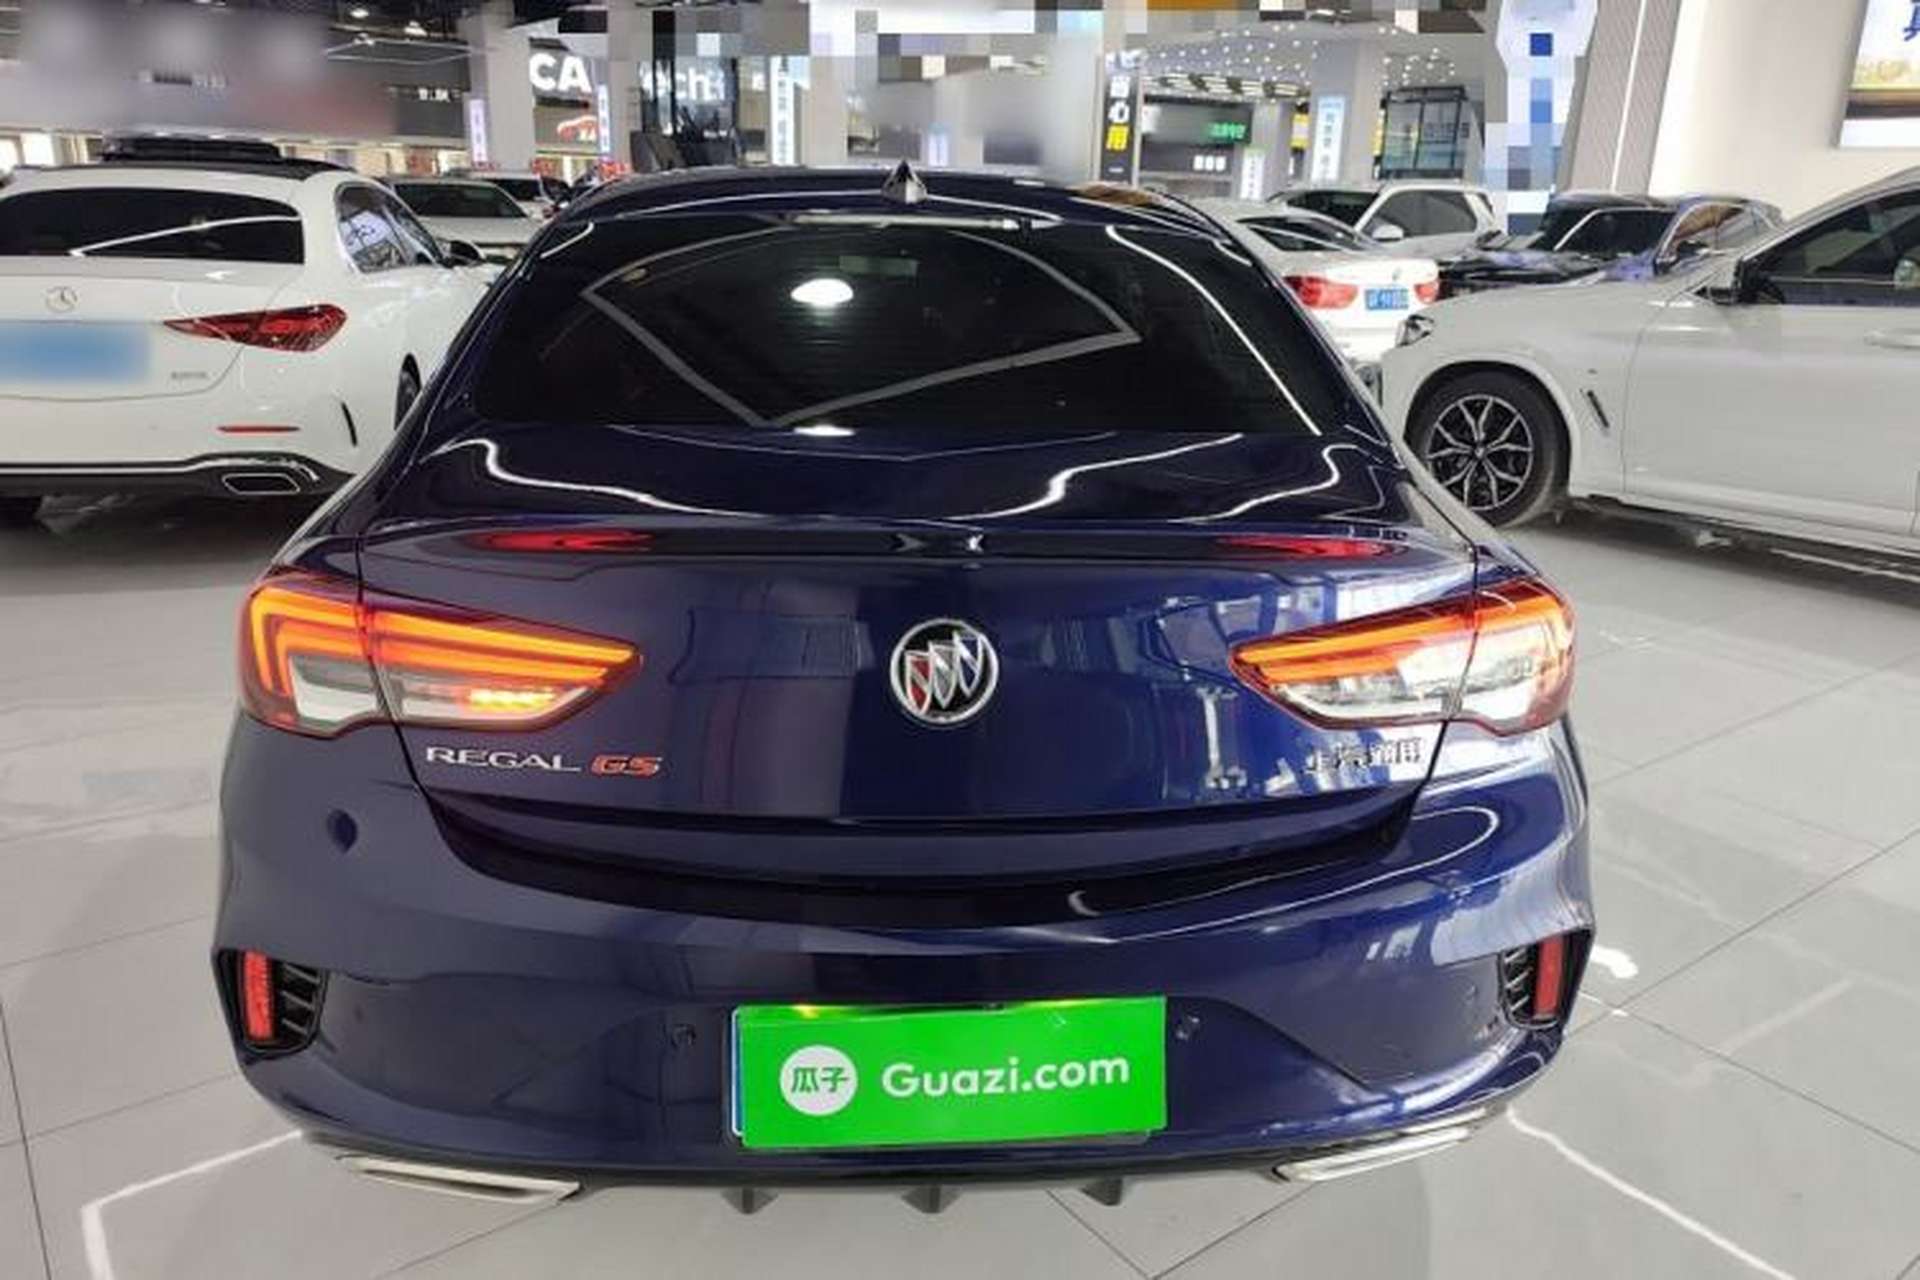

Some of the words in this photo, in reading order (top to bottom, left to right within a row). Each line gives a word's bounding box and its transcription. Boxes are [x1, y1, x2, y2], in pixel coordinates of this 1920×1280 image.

[426, 747, 581, 771] REGAL
[590, 755, 662, 776] GS
[790, 1066, 848, 1093] 瓜子
[882, 1057, 1129, 1098] Guazi.com
